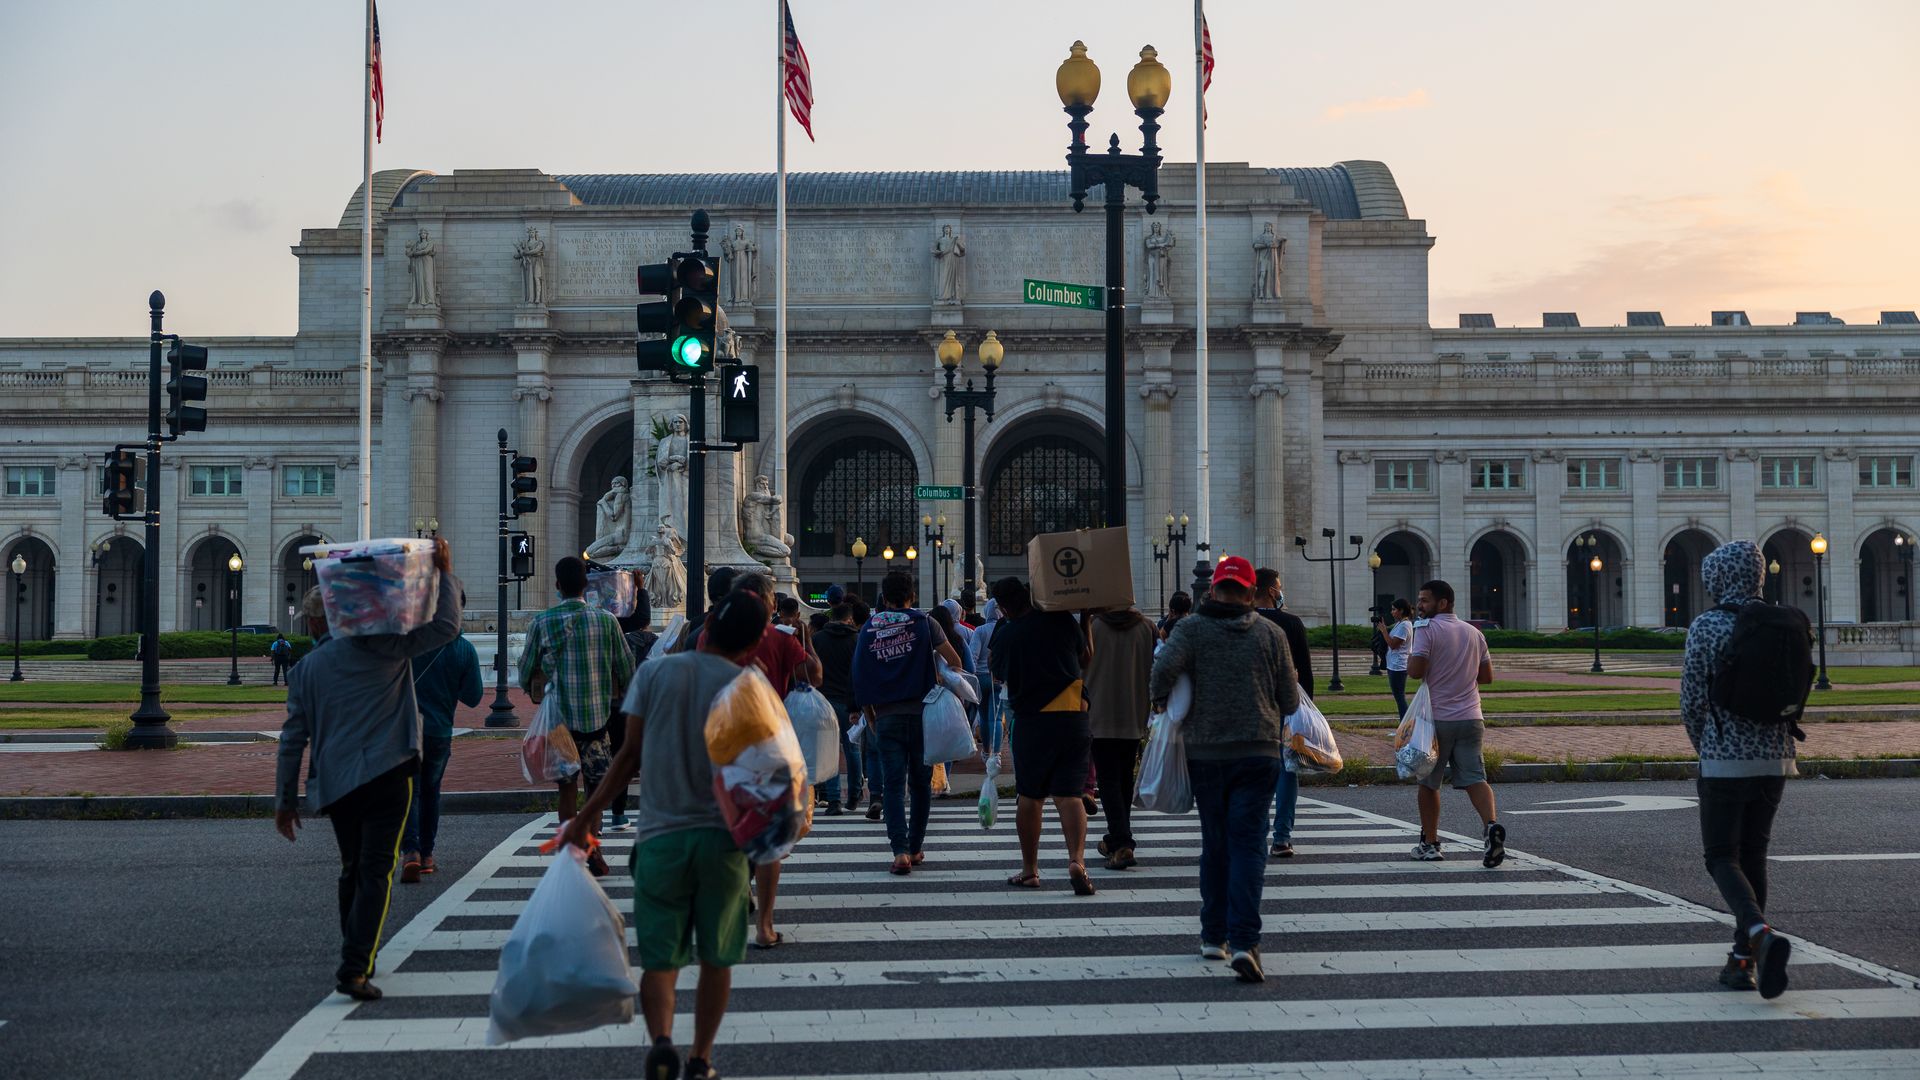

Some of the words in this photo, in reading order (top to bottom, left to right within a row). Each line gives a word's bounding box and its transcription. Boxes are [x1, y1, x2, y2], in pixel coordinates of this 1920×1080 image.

[1028, 282, 1082, 305] Columbus
[917, 487, 950, 498] Columbus
[876, 642, 913, 660] ALWAYS
